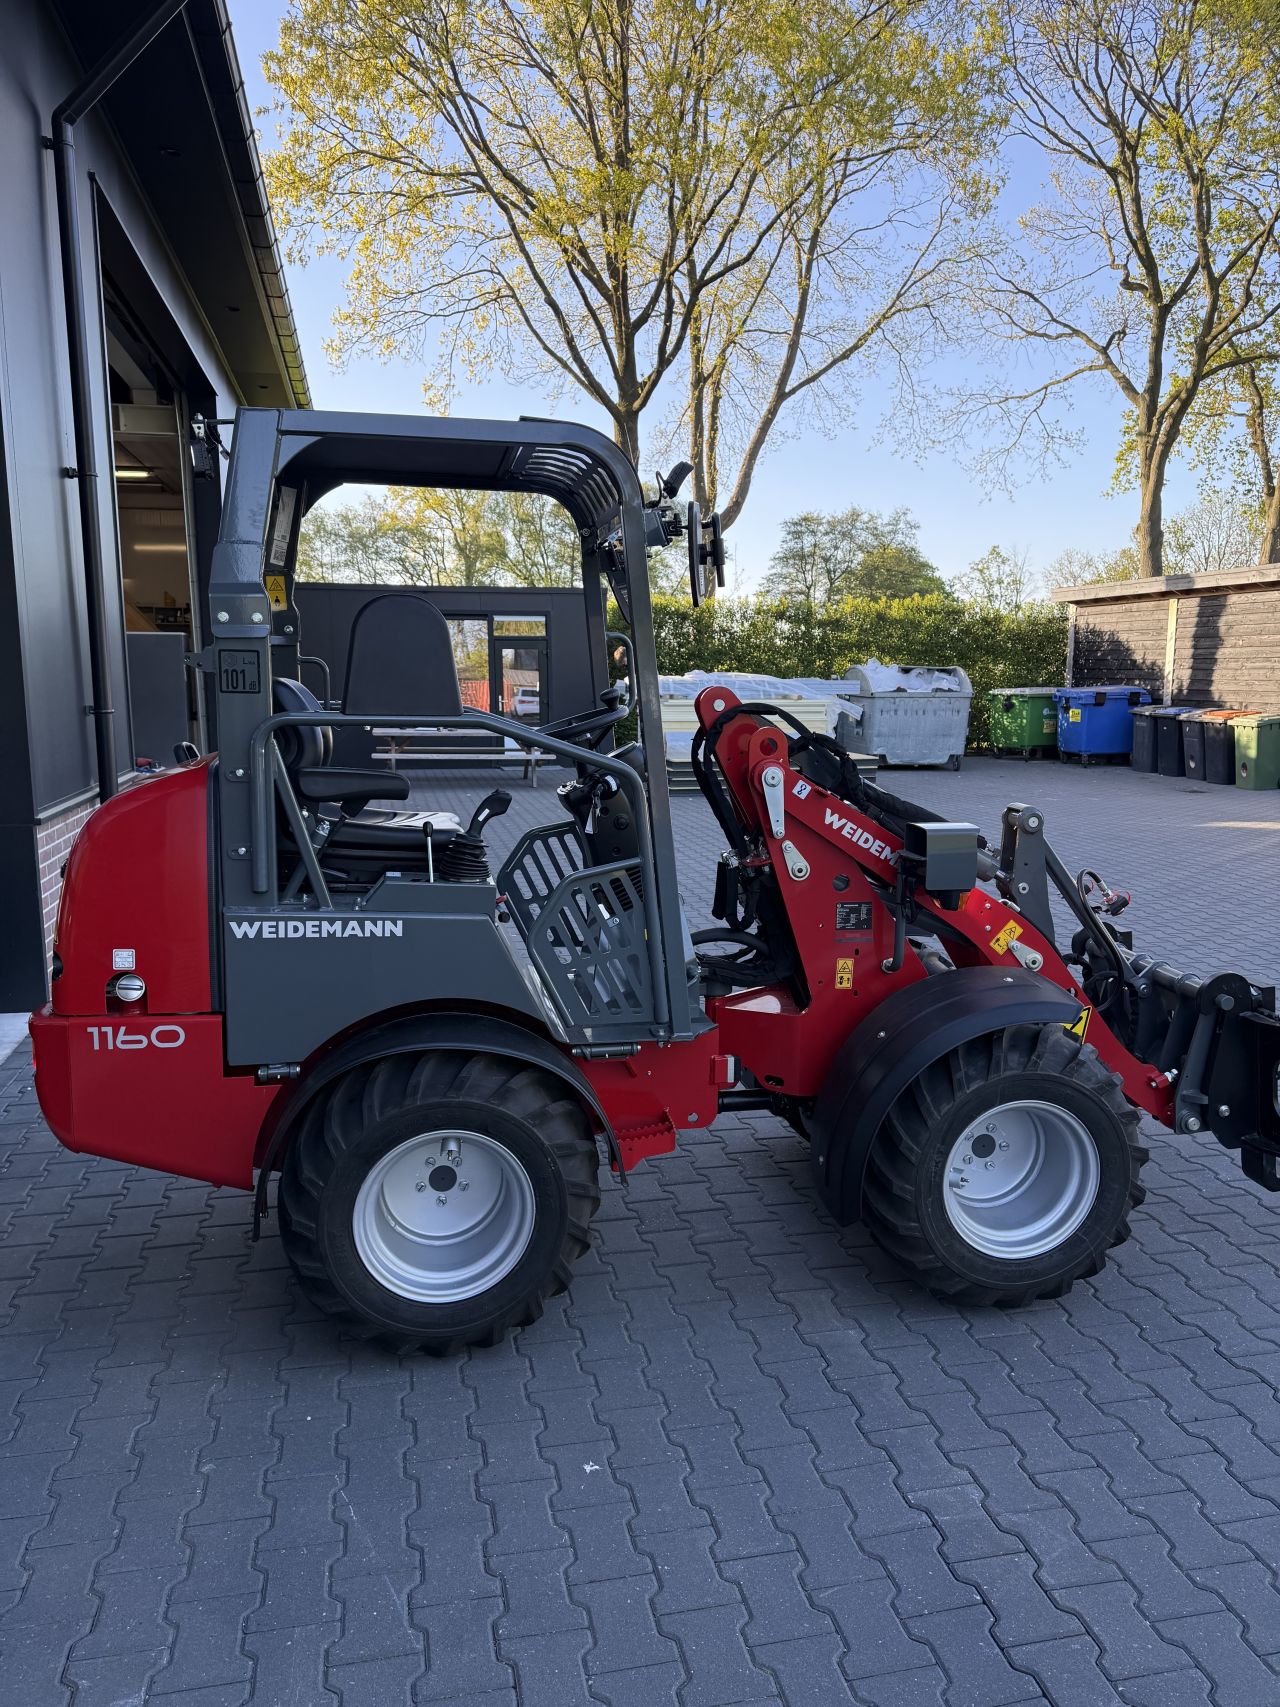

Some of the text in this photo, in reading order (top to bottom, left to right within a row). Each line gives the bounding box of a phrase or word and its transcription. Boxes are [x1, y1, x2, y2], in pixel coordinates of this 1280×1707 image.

[223, 669, 246, 690] 101
[824, 807, 899, 866] WEIDEM
[229, 920, 403, 939] WEIDEMANN
[87, 1025, 186, 1051] 1160
